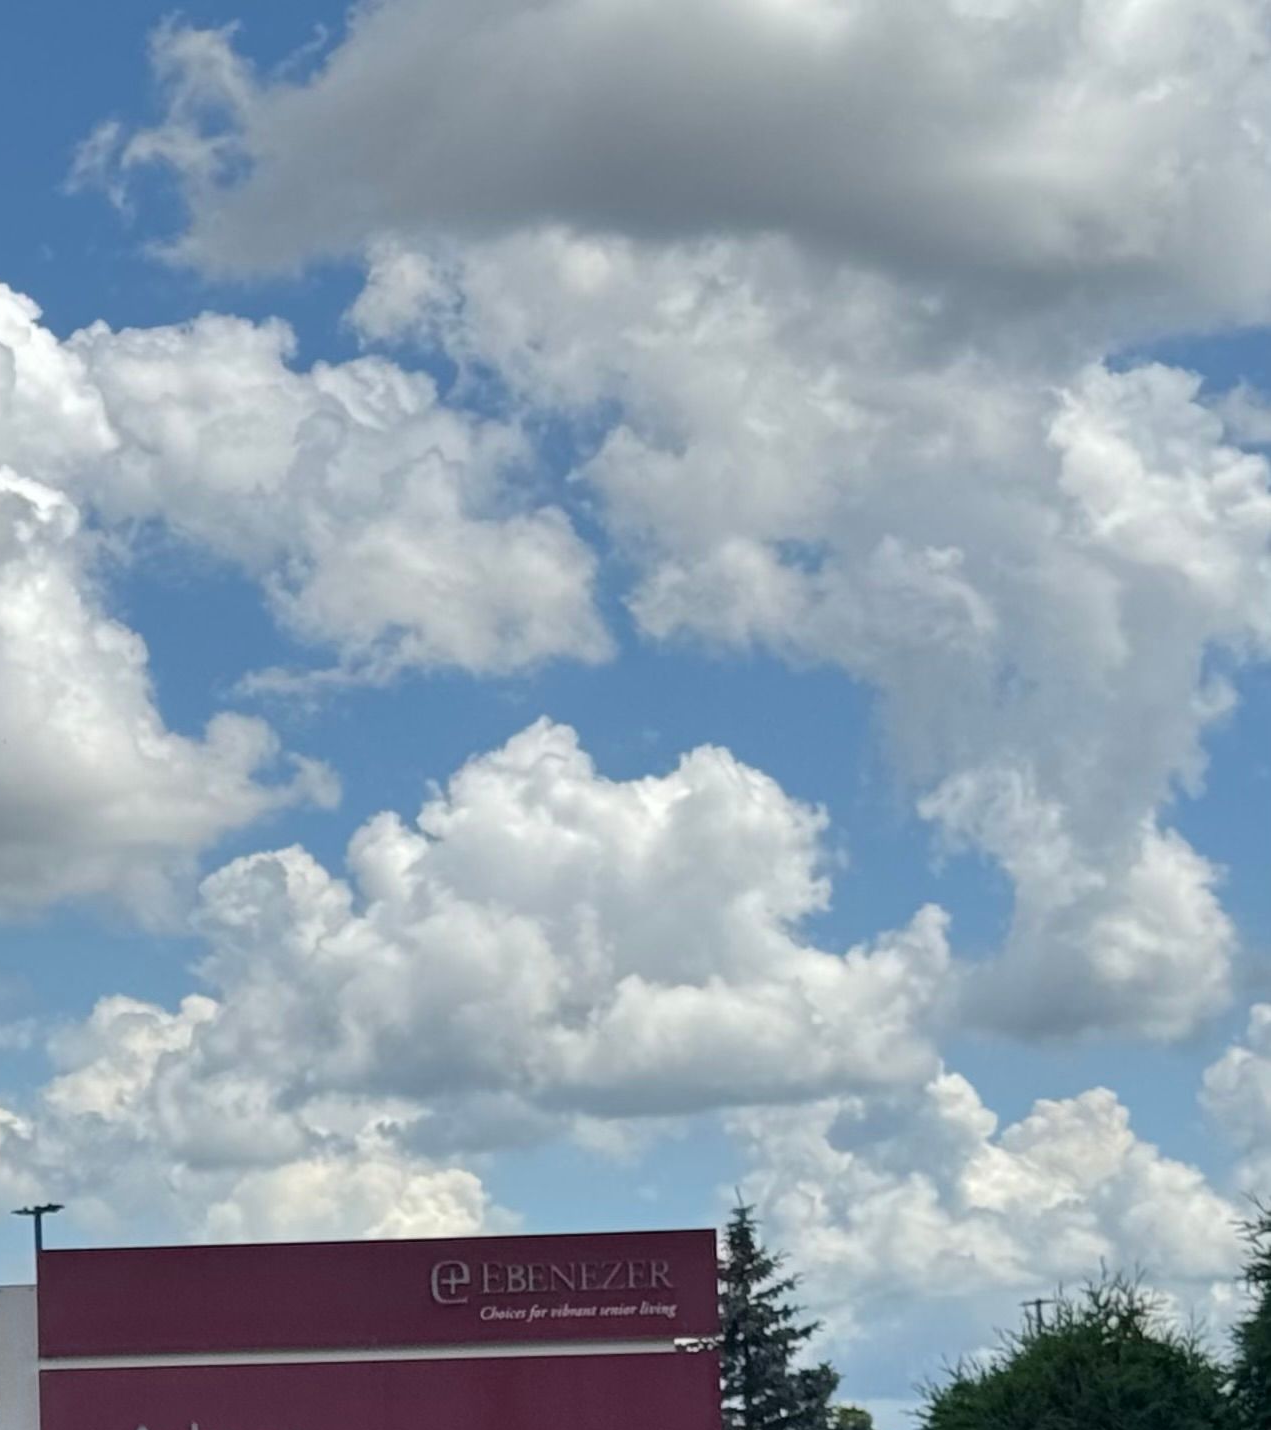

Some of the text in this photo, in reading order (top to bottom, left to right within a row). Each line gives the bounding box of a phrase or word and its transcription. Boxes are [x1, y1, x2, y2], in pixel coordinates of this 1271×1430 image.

[482, 1259, 674, 1294] EBENEZER
[480, 1300, 678, 1323] Choices for vibrant senior living
